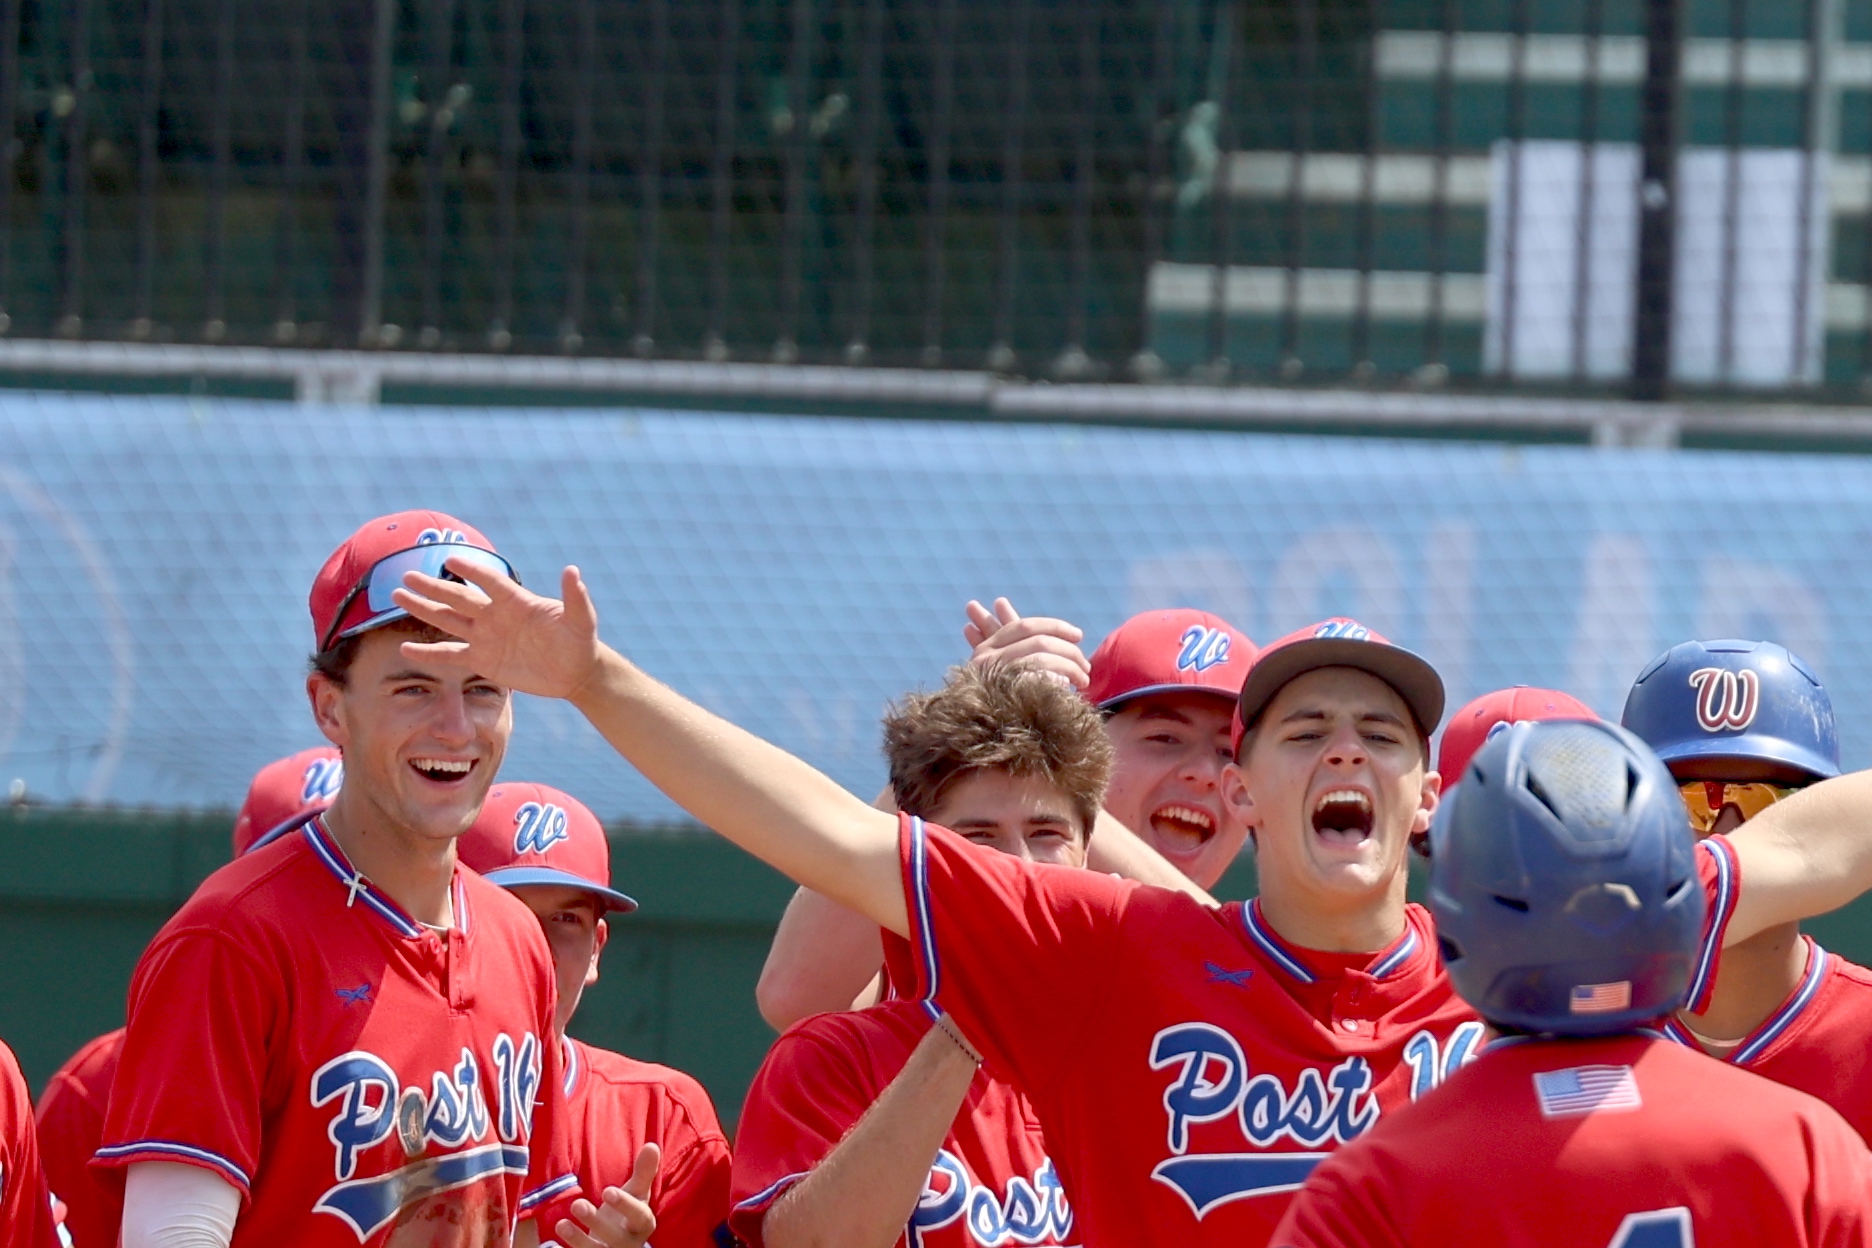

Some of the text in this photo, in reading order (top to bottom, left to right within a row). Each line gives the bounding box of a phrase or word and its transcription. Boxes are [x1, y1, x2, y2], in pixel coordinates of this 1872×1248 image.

[1176, 624, 1231, 672] W
[1689, 667, 1758, 732] W
[512, 801, 569, 855] W
[310, 1050, 489, 1182] Post
[1149, 1021, 1380, 1155] Post
